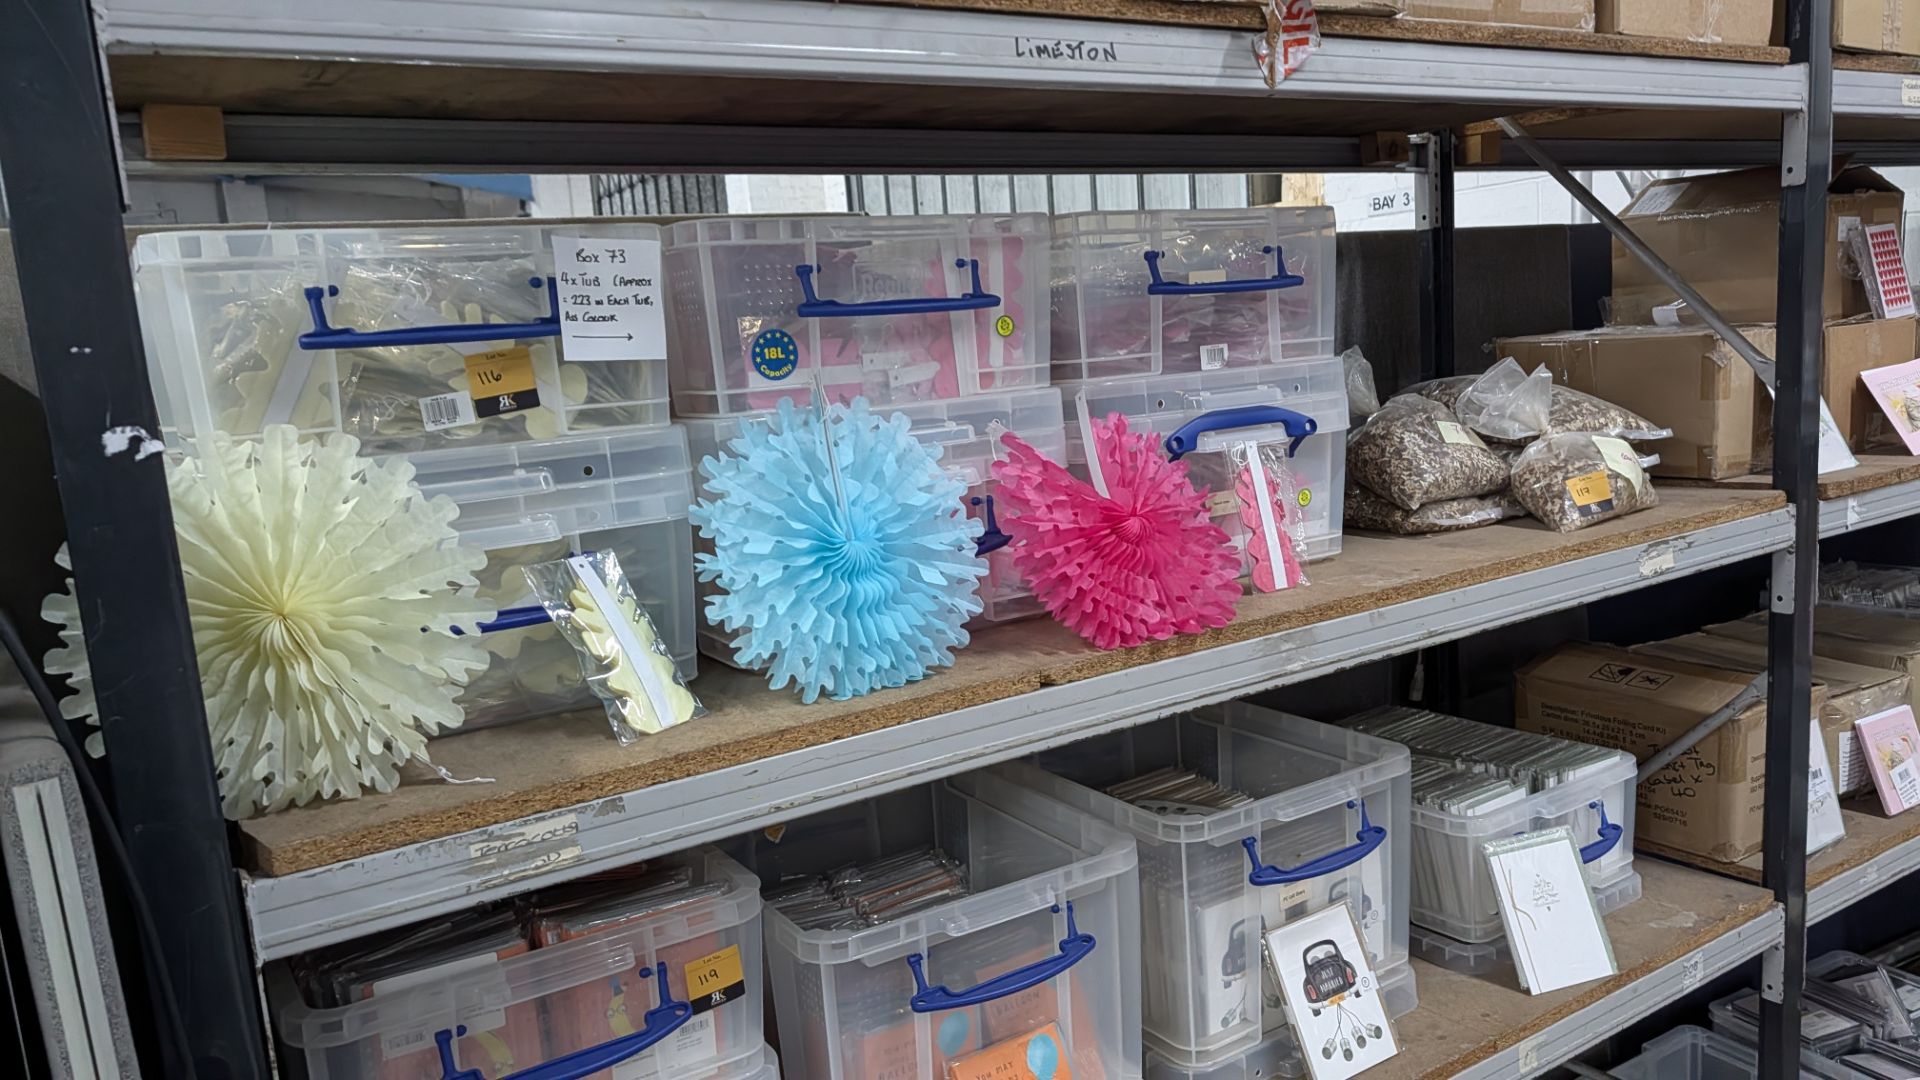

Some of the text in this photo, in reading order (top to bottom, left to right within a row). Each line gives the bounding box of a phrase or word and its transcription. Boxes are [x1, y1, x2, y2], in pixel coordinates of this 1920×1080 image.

[1372, 192, 1410, 211] BAY 3
[605, 249, 626, 263] 73
[571, 294, 591, 306] 223
[764, 347, 785, 360] 18L
[477, 369, 502, 385] 116
[760, 363, 793, 377] Capacity
[1581, 710, 1611, 723] Frivolous
[1637, 722, 1655, 732] Card
[1671, 787, 1696, 798] 40
[698, 968, 719, 986] 119
[1319, 976, 1344, 993] MARRIED
